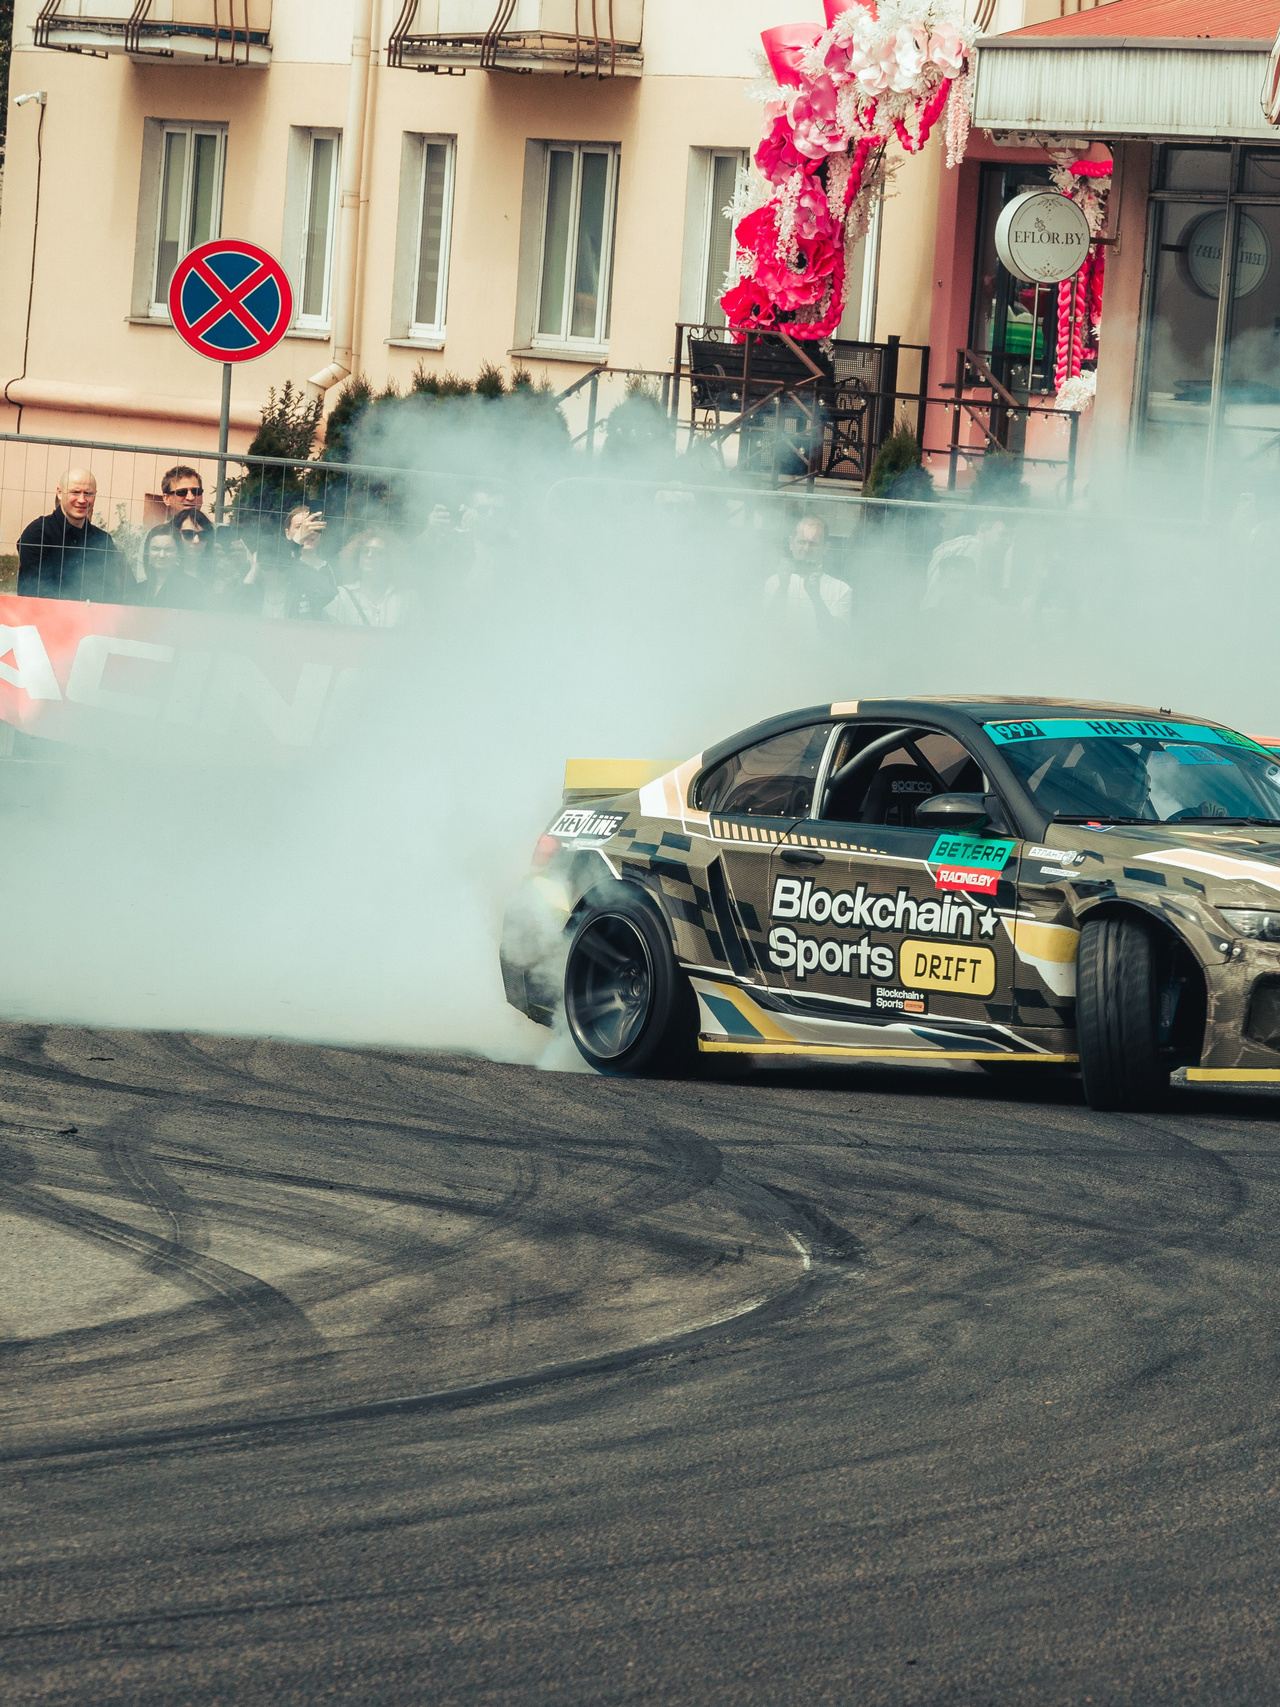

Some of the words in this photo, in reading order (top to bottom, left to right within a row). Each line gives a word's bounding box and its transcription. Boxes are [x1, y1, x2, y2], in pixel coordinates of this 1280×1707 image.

[1014, 231, 1085, 246] EFLOR.BY
[994, 722, 1038, 739] 999
[935, 841, 1007, 862] BETERA
[771, 878, 972, 936] Blockchain
[768, 927, 894, 978] Sports
[914, 953, 981, 984] DRIFT
[876, 987, 919, 1000] Blockchain
[876, 997, 904, 1009] Sports
